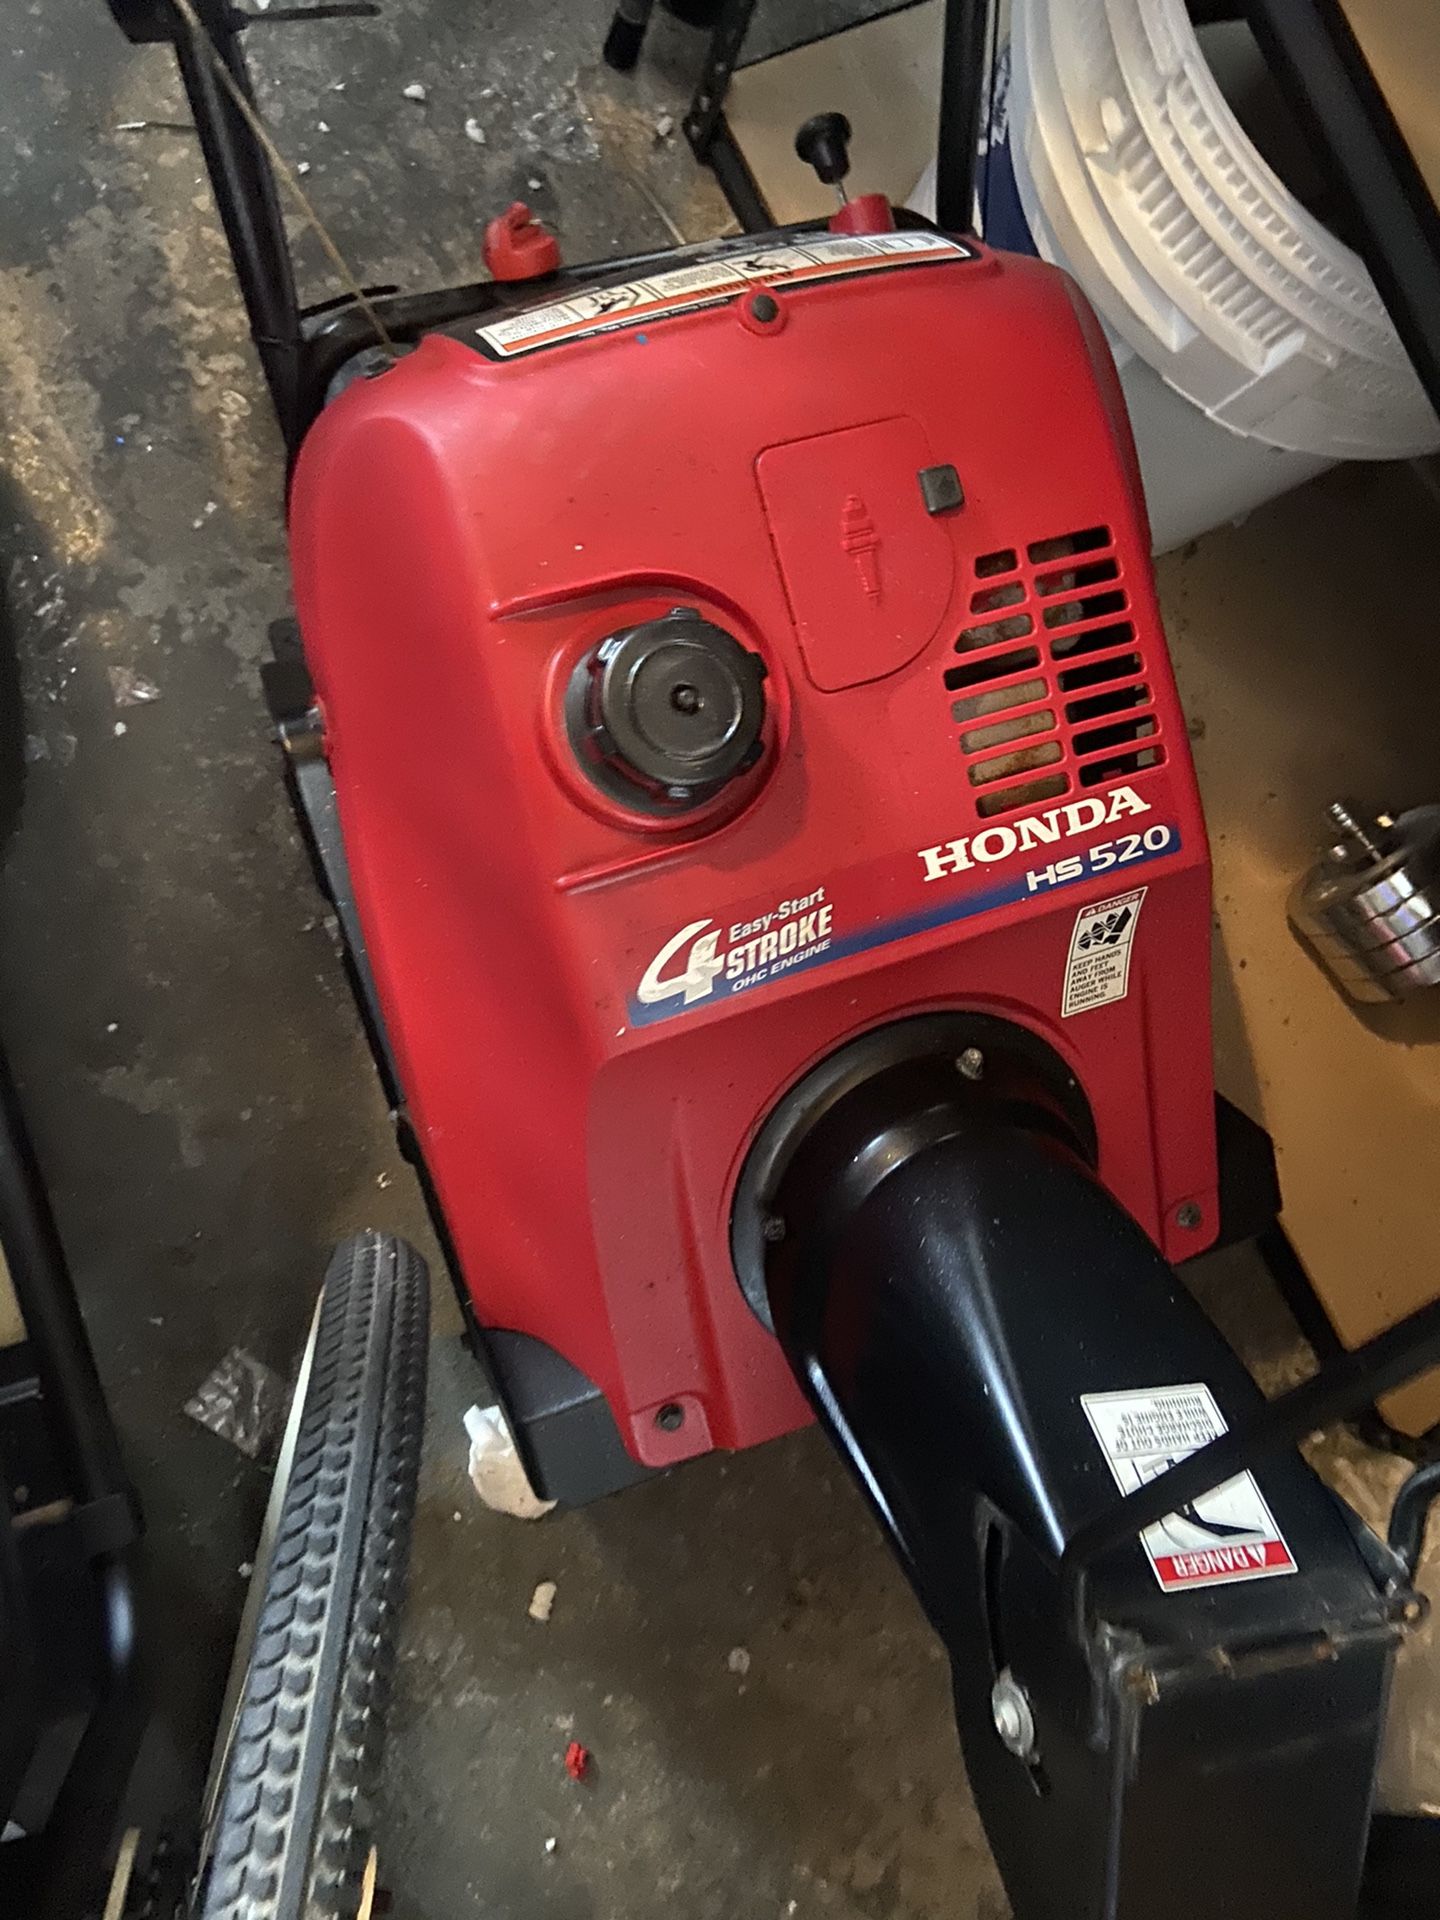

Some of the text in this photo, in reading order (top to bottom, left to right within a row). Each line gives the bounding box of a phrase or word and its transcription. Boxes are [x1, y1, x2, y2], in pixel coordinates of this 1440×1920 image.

[917, 785, 1151, 882] HONDA
[1026, 824, 1171, 892] HS 520
[728, 886, 825, 944] Easy-Start
[1096, 893, 1140, 913] DANGER
[726, 904, 833, 980] STROKE
[638, 918, 725, 1005] 4
[731, 939, 831, 992] OHC ENGINE
[1071, 961, 1109, 978] AND FEET
[1072, 950, 1122, 970] KEEP HANDS
[1070, 966, 1116, 986] AWAY FROM
[1070, 971, 1122, 993] AUGER WHILE
[1069, 988, 1098, 1001] ENGINE
[1172, 1546, 1250, 1577] DANGER
